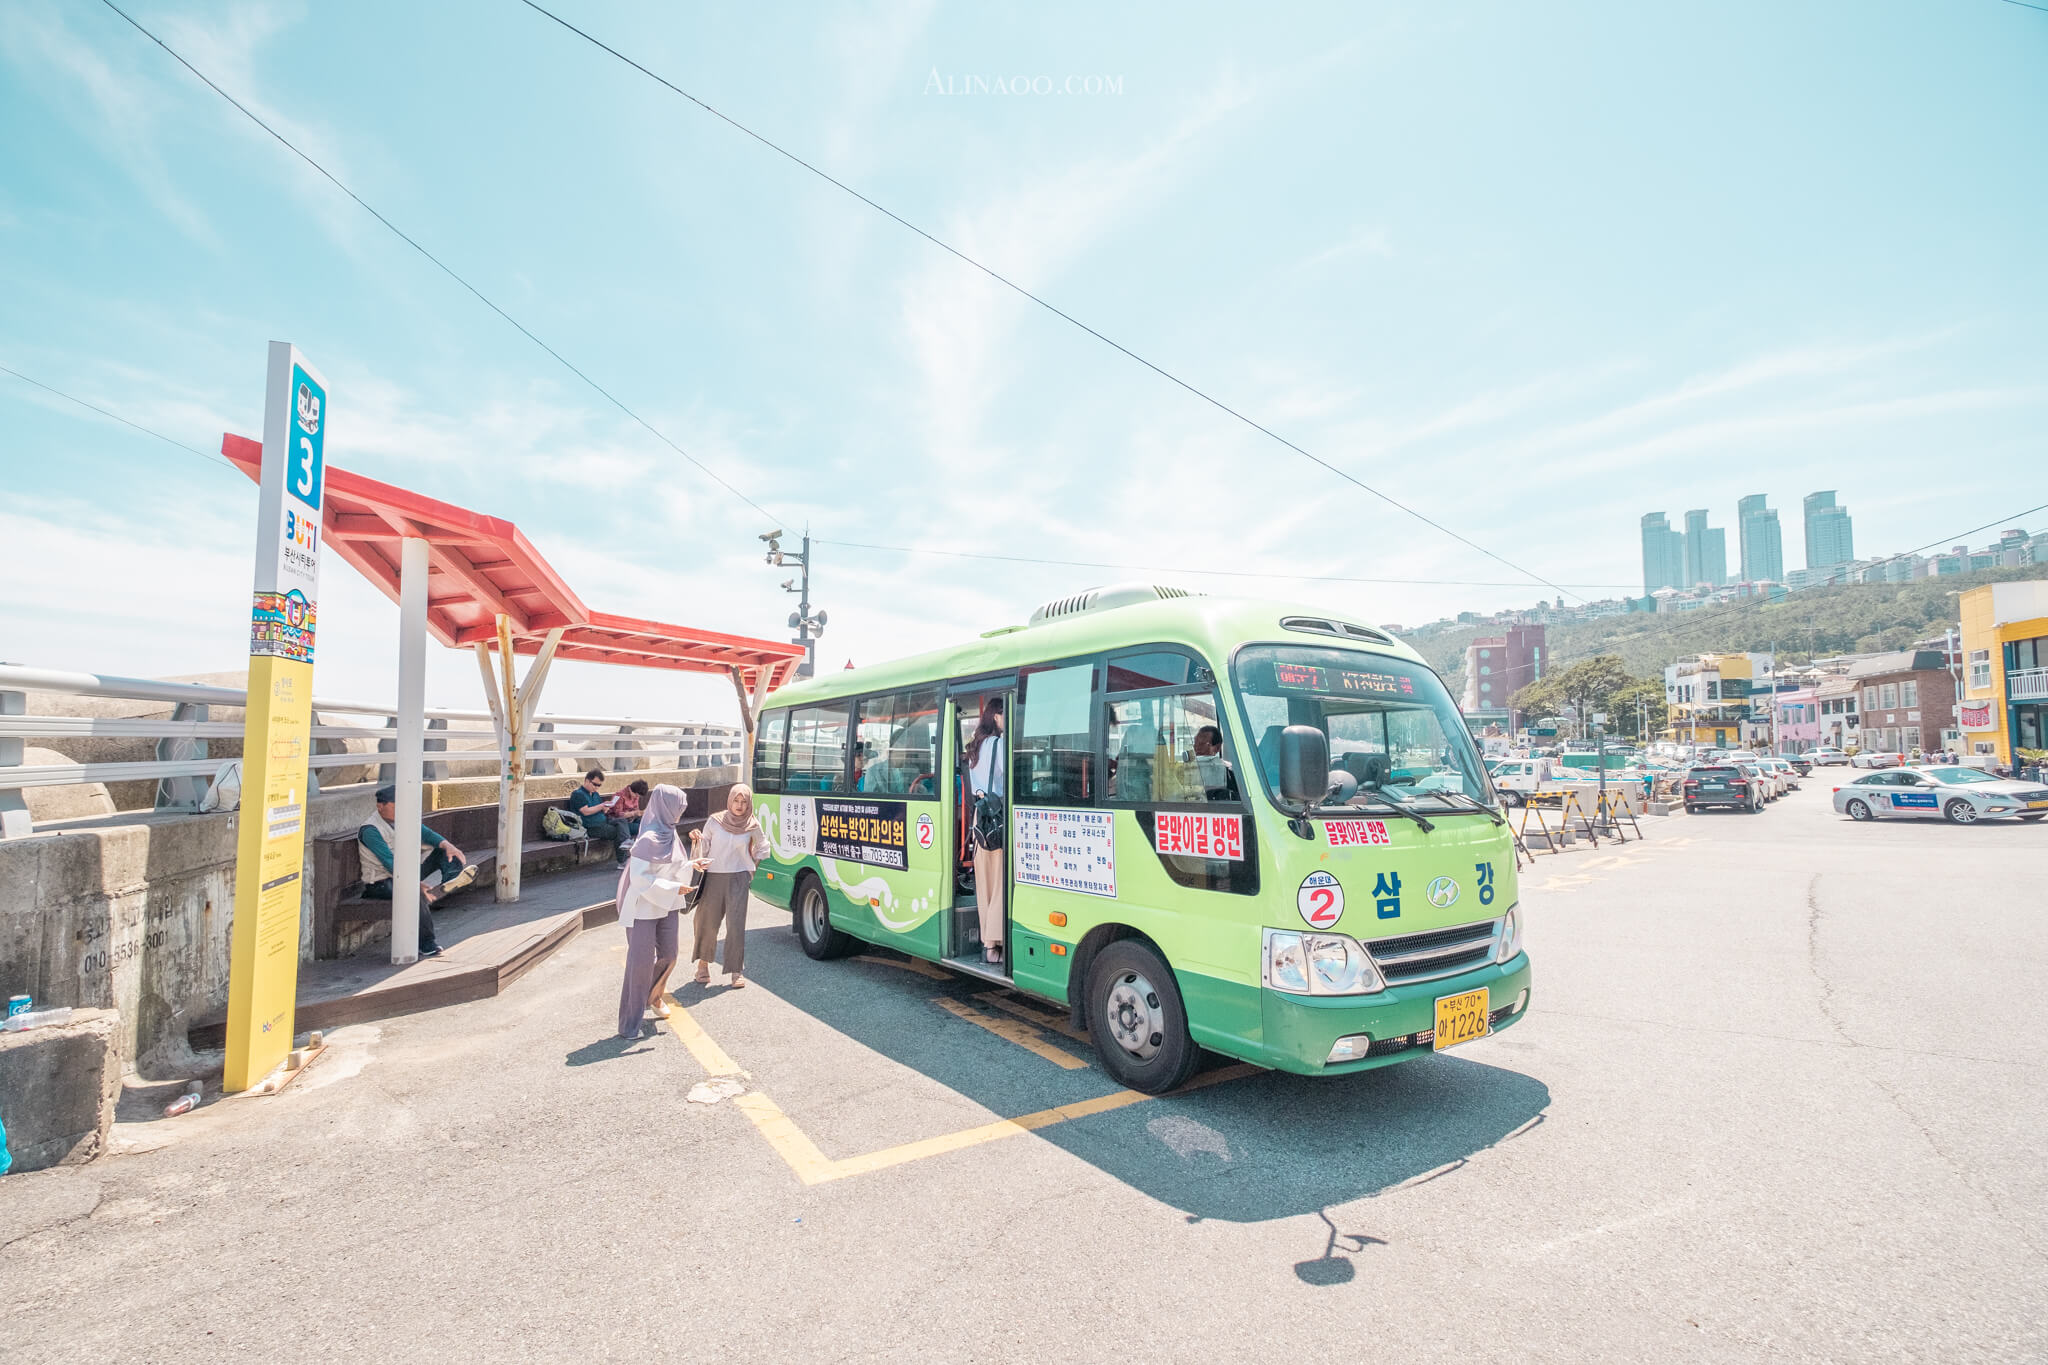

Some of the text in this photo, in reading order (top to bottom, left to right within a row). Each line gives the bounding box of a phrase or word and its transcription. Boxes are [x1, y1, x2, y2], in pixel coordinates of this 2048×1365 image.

[297, 437, 314, 497] 3
[286, 509, 317, 553] BUTI
[920, 824, 931, 844] 2
[1157, 815, 1241, 857] 달맞이길 방면
[1325, 821, 1389, 845] 달맞이길 방면
[1310, 889, 1336, 921] 2
[1372, 862, 1494, 920] 삼 강
[1450, 995, 1476, 1012] 부산 70
